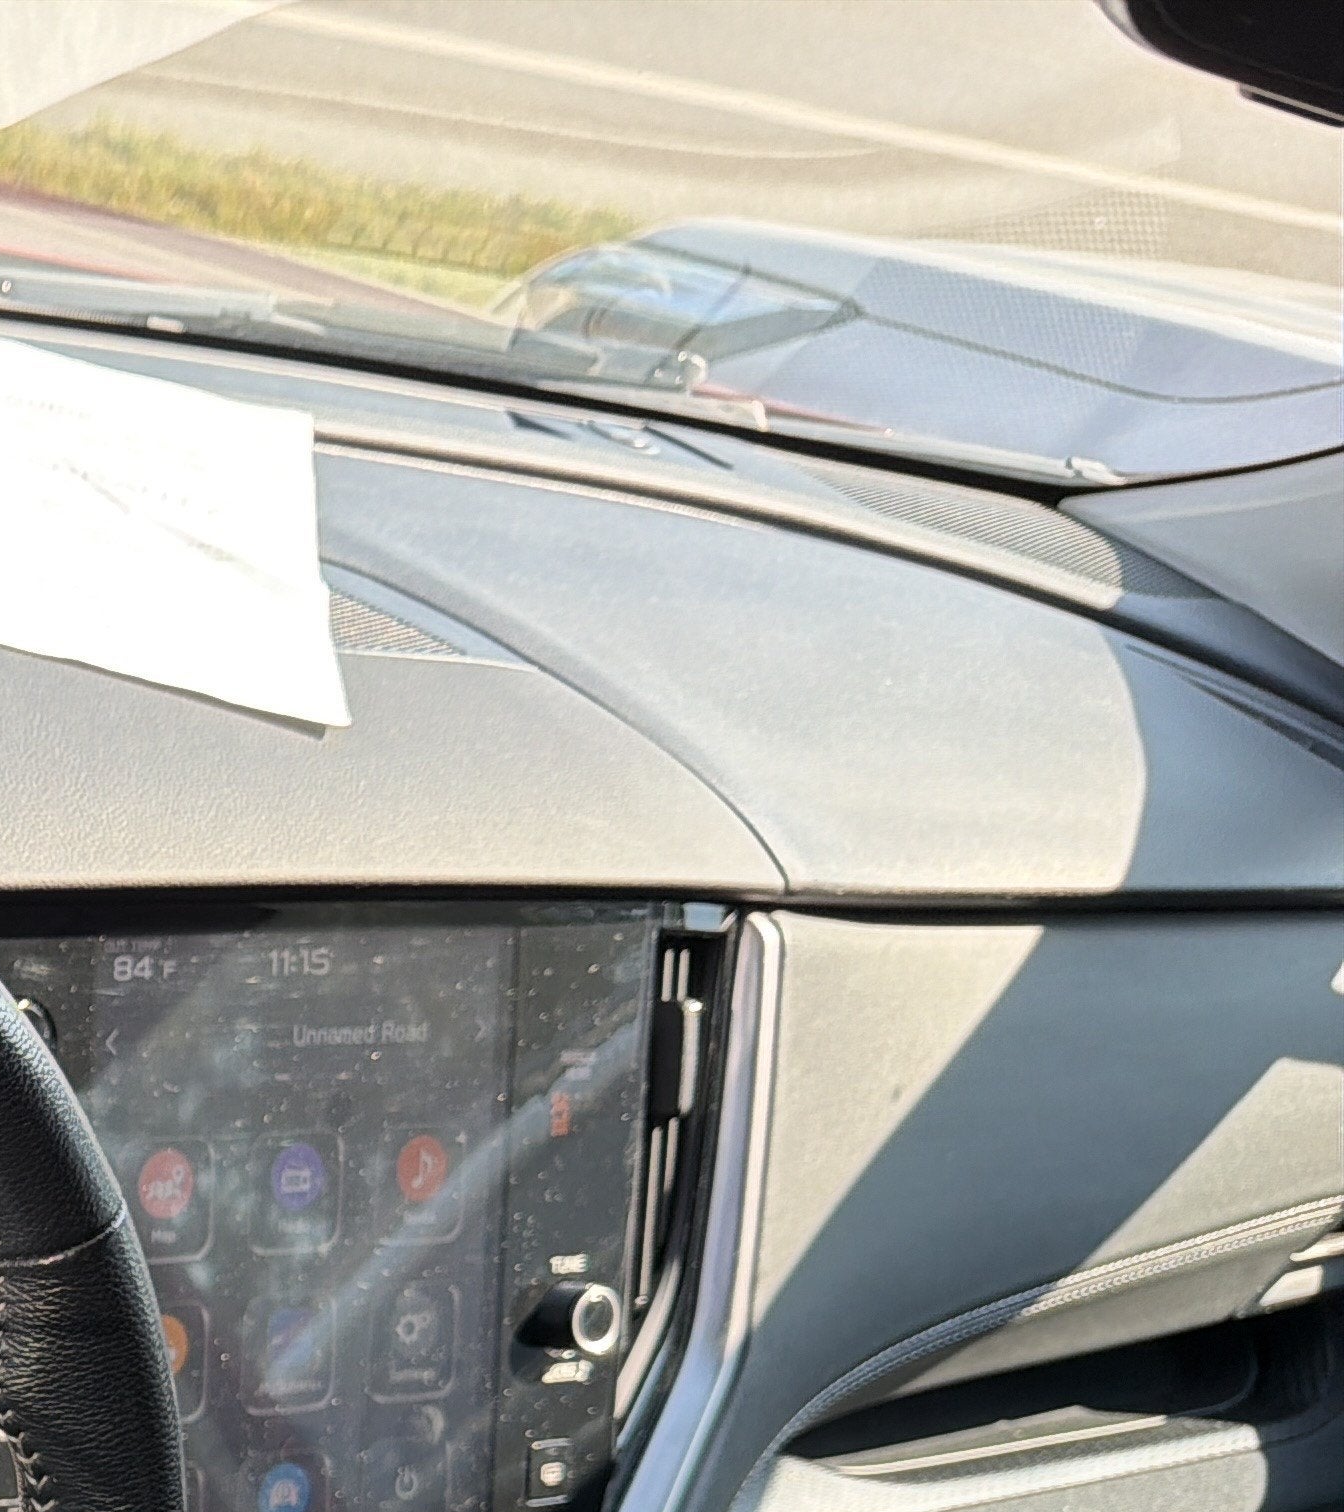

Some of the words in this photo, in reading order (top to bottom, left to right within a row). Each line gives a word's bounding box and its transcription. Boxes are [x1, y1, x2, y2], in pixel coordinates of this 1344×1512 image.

[268, 946, 331, 976] 11:15
[293, 1022, 375, 1047] Unnamed
[380, 1018, 430, 1043] Road
